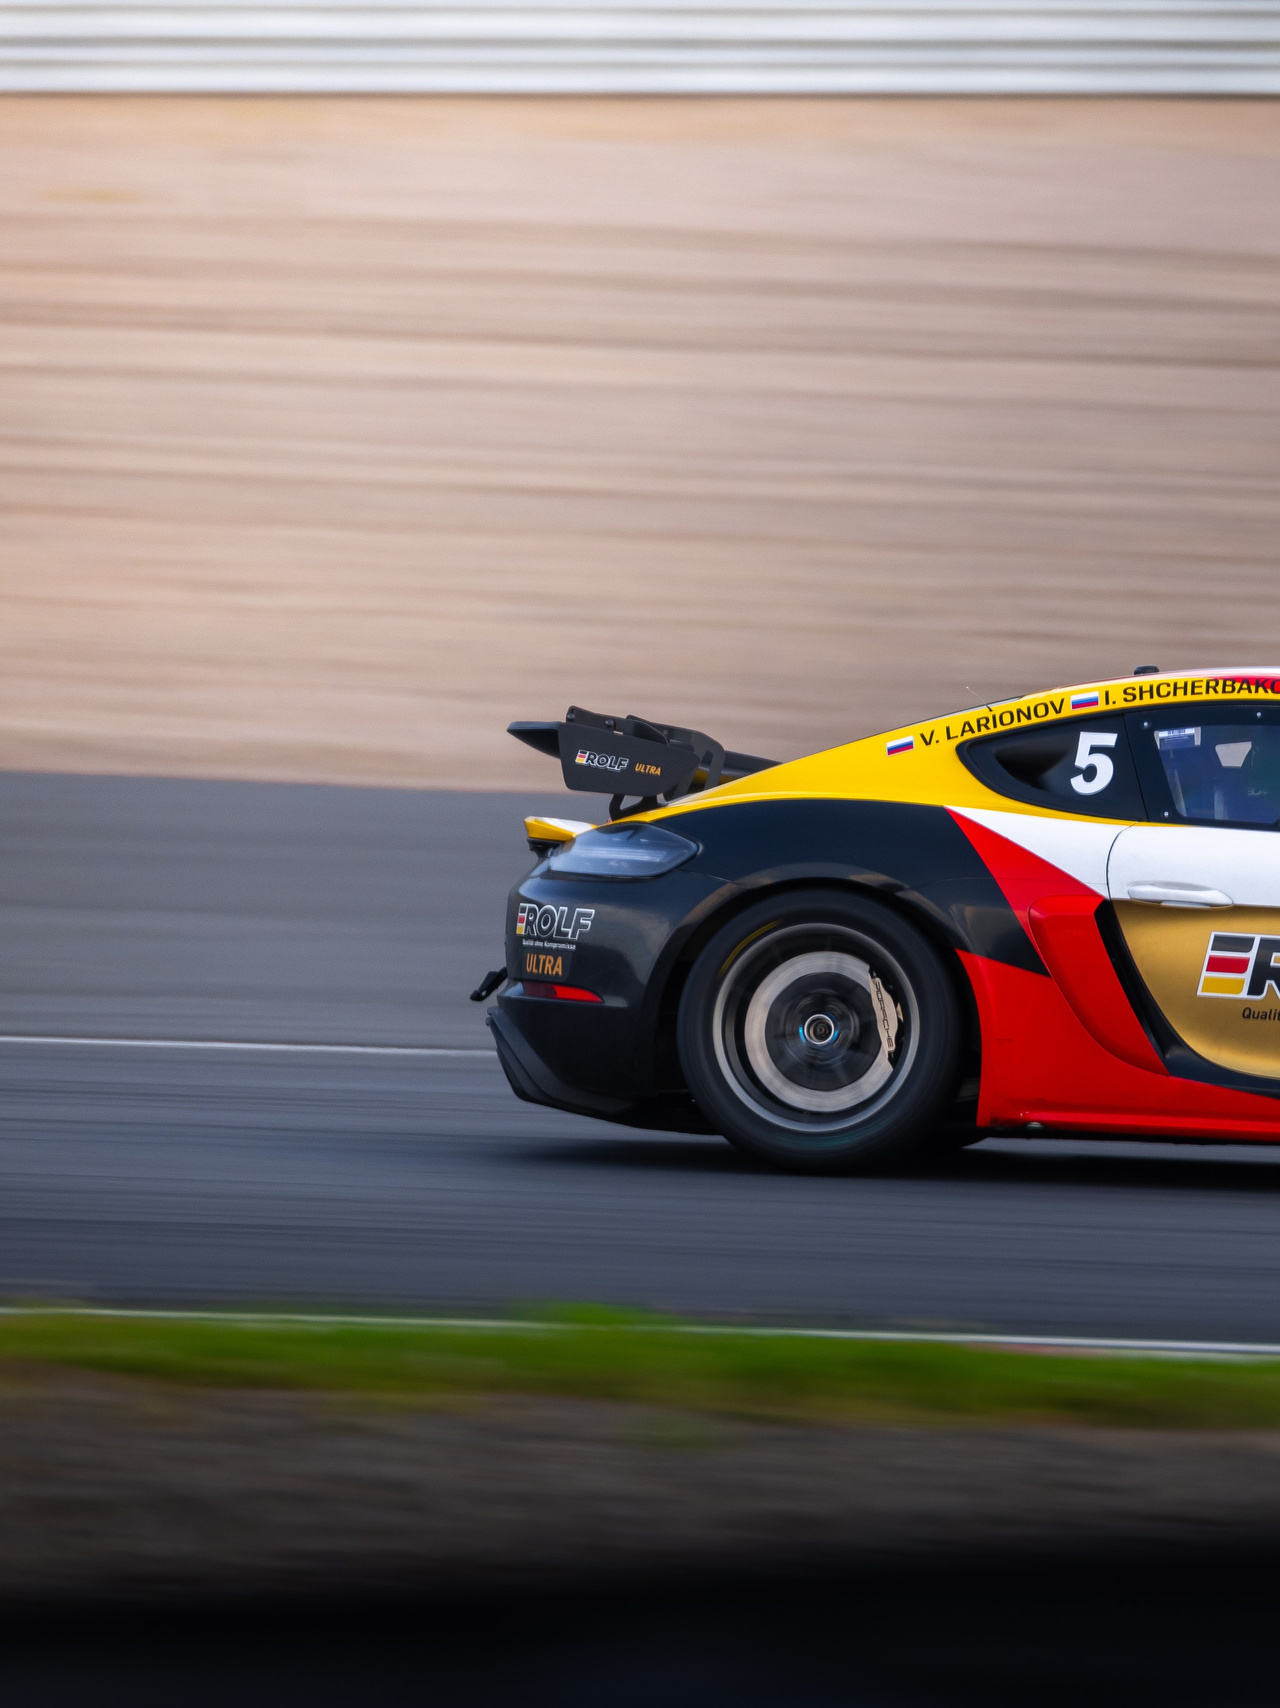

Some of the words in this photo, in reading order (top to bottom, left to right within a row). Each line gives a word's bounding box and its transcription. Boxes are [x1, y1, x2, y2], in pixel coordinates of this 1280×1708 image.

[1105, 690, 1118, 706] I.
[919, 730, 940, 746] V.
[946, 698, 1065, 741] LARIONOV
[585, 751, 630, 771] ROLF
[635, 763, 661, 776] ULTRA
[1070, 731, 1118, 796] 5
[523, 903, 595, 940] ROLF
[526, 953, 562, 976] ULTRA
[875, 981, 894, 1048] PORSCHE
